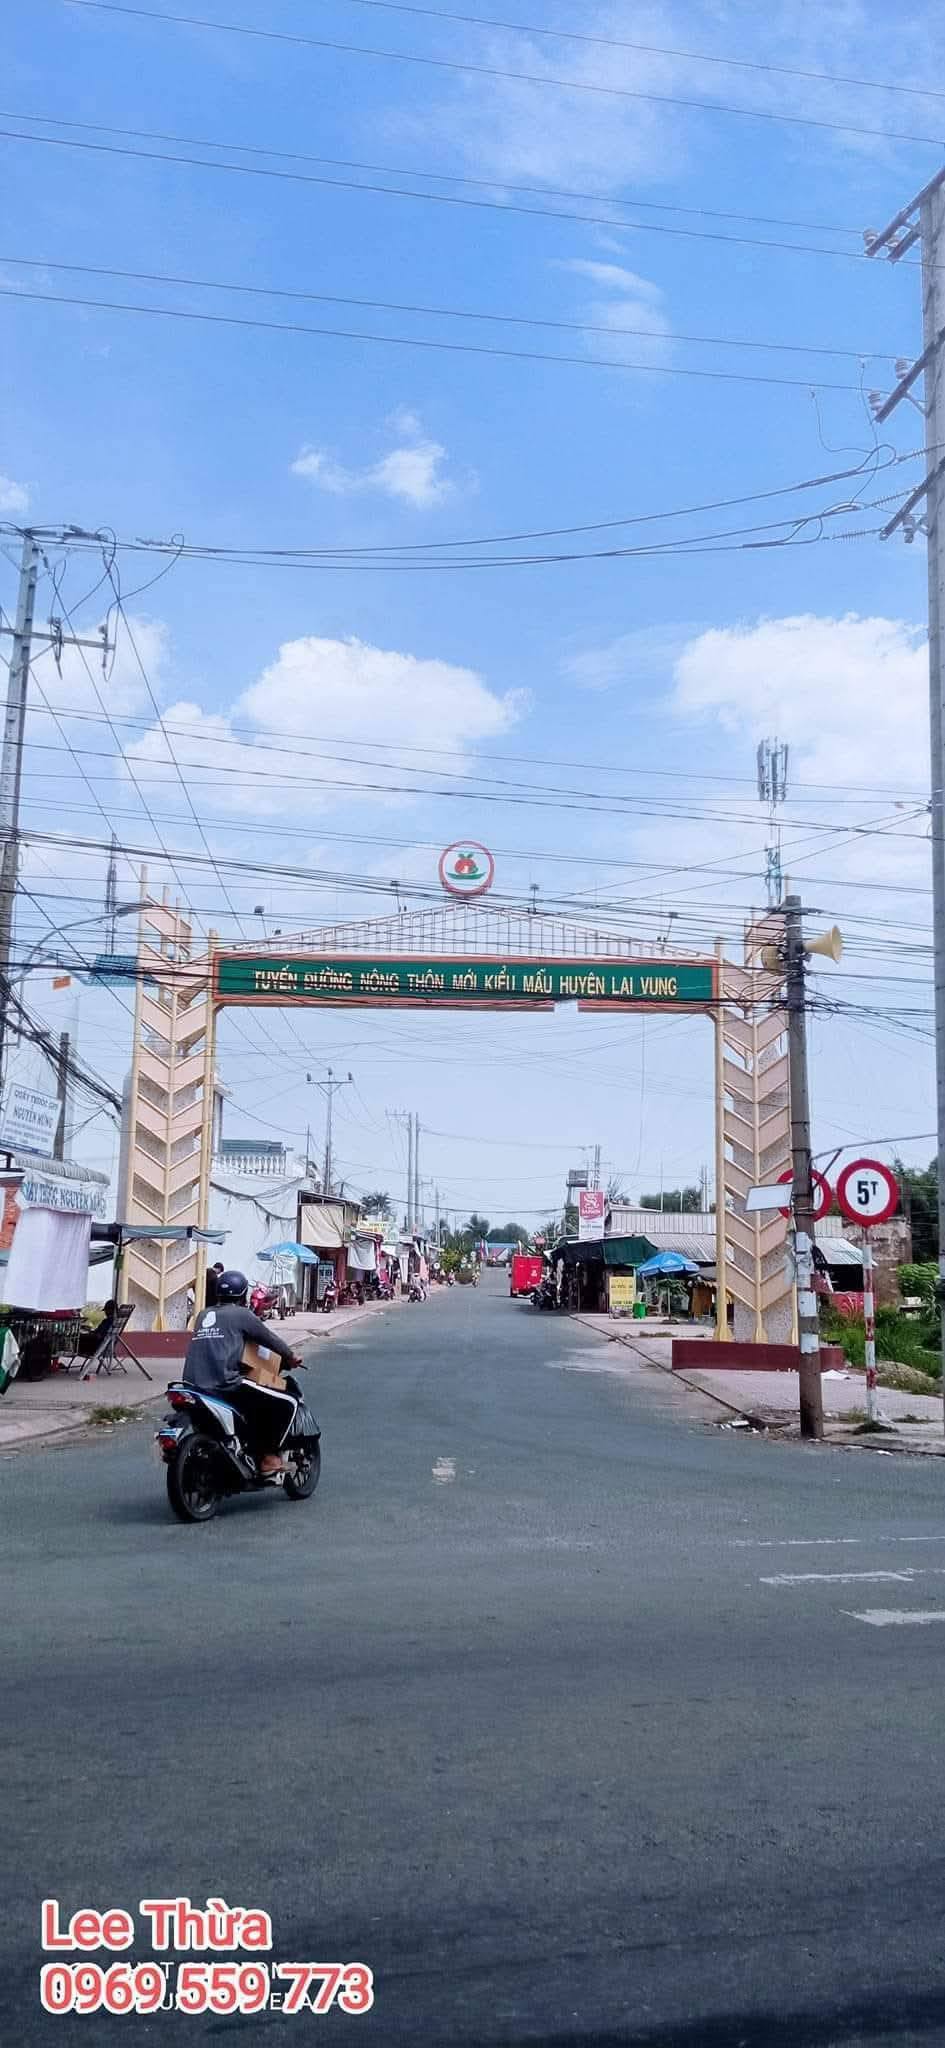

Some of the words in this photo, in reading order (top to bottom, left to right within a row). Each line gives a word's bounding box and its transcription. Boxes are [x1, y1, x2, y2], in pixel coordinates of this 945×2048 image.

[255, 964, 297, 990] TUYẾN
[360, 968, 399, 992] NÔNG
[407, 969, 444, 992] THÔN
[453, 968, 477, 991] MỚI
[485, 964, 515, 992] KIỂU
[523, 968, 552, 994] MẪU
[612, 976, 633, 996] LAI
[640, 976, 677, 997] VUNG
